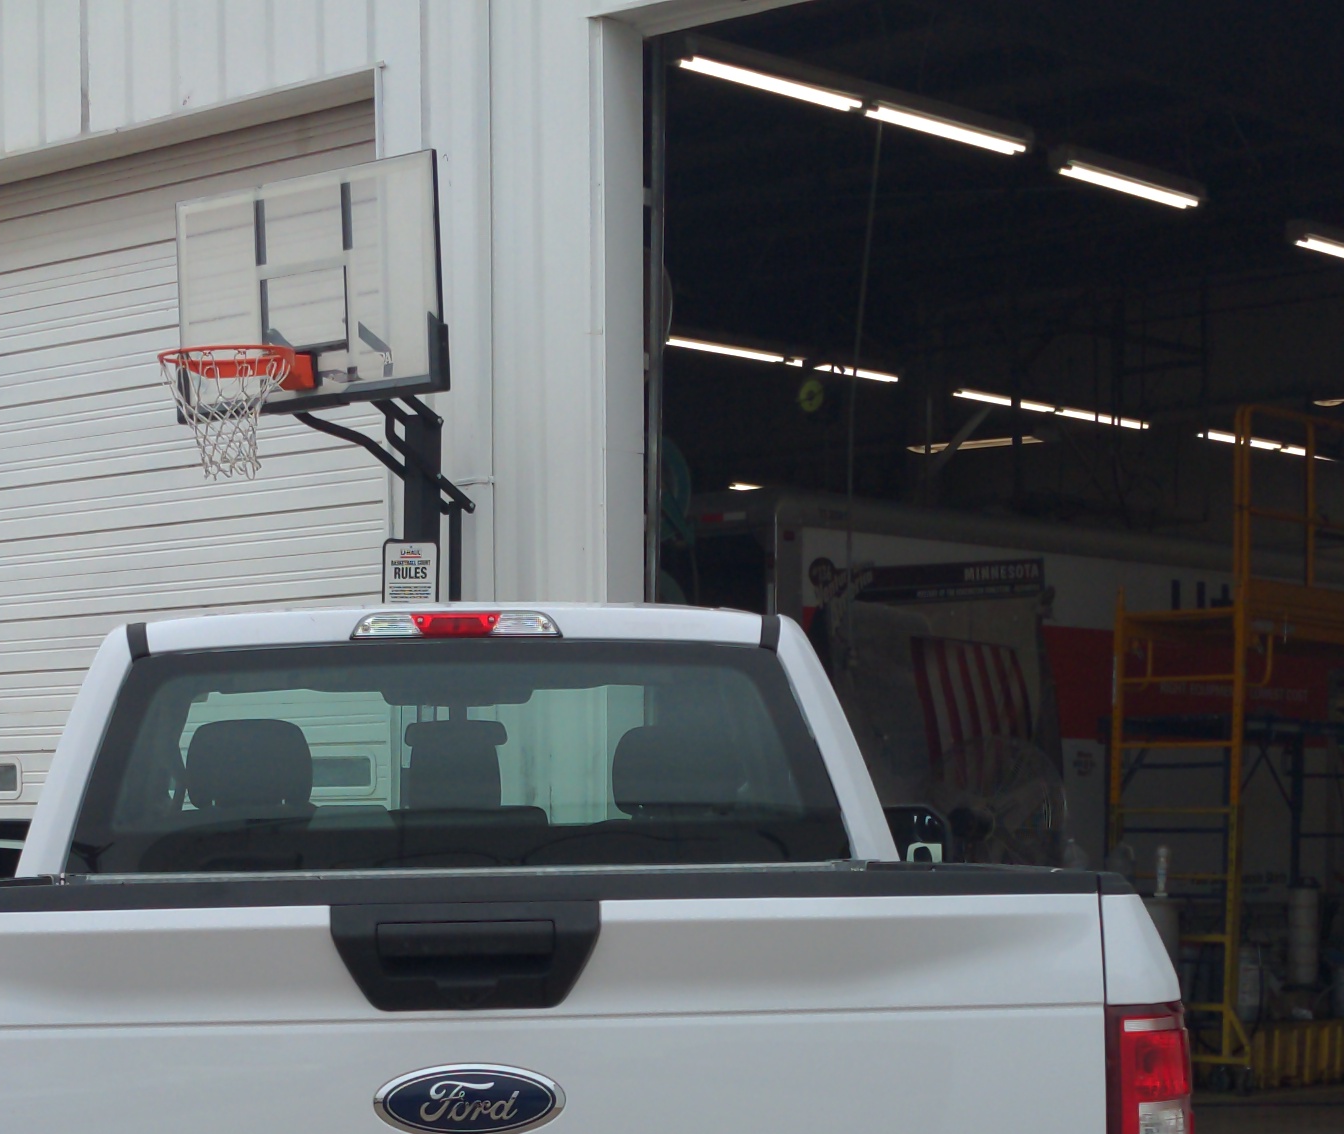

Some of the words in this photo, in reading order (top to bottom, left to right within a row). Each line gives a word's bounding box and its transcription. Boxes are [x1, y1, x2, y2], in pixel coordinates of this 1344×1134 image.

[394, 566, 428, 580] RULES
[963, 563, 1039, 582] MINNESOTA
[419, 1080, 520, 1122] Ford
